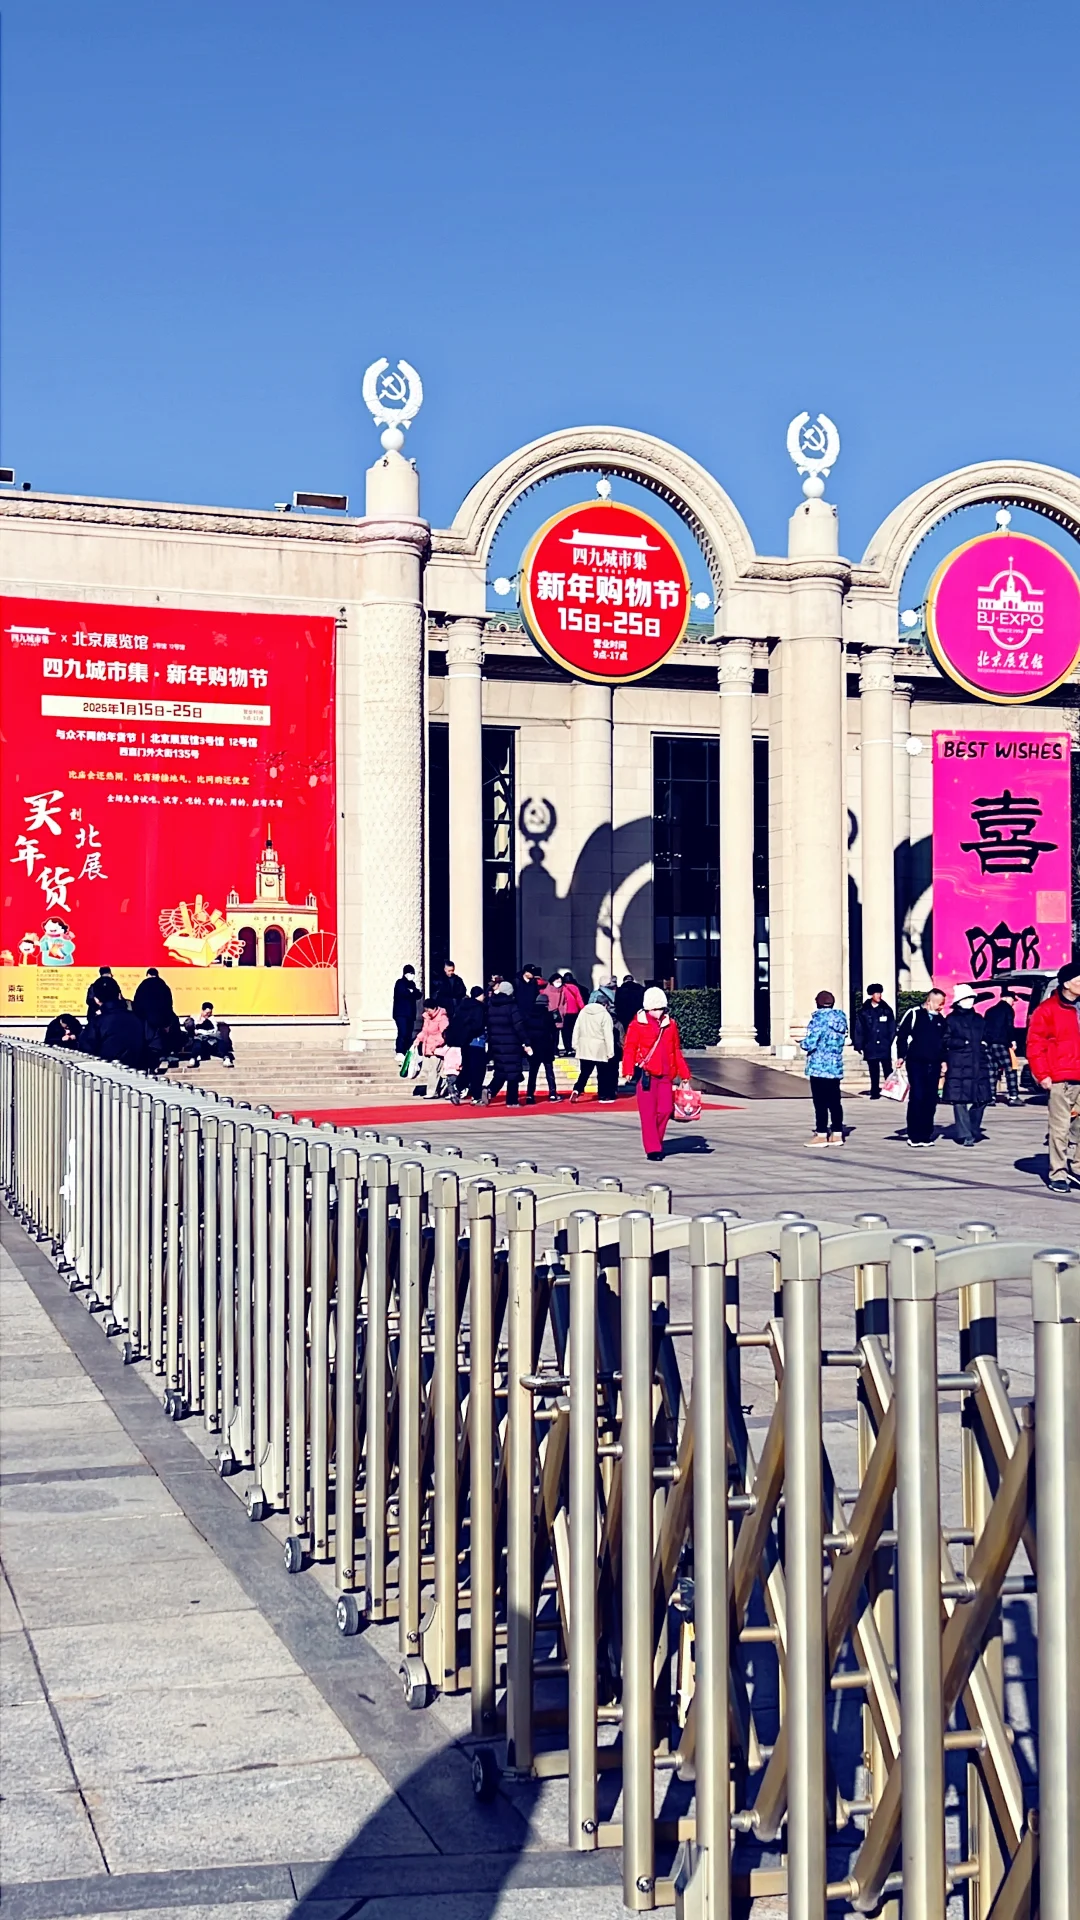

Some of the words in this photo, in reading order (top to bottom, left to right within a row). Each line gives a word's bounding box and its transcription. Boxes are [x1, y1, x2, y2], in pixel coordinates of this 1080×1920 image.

[572, 547, 647, 570] 四九城市集
[536, 570, 681, 610] 新年购物节
[557, 606, 661, 638] 15日-25日
[72, 631, 149, 650] 北京展览馆
[593, 638, 628, 650] 营业时间
[593, 650, 628, 661] 9点-17点
[83, 702, 202, 719] 2025年1月15日-25日
[56, 729, 137, 743] 与众不同的年货节
[943, 741, 989, 758] BEST
[995, 742, 1063, 760] WISHES
[9, 789, 75, 913] 买年货
